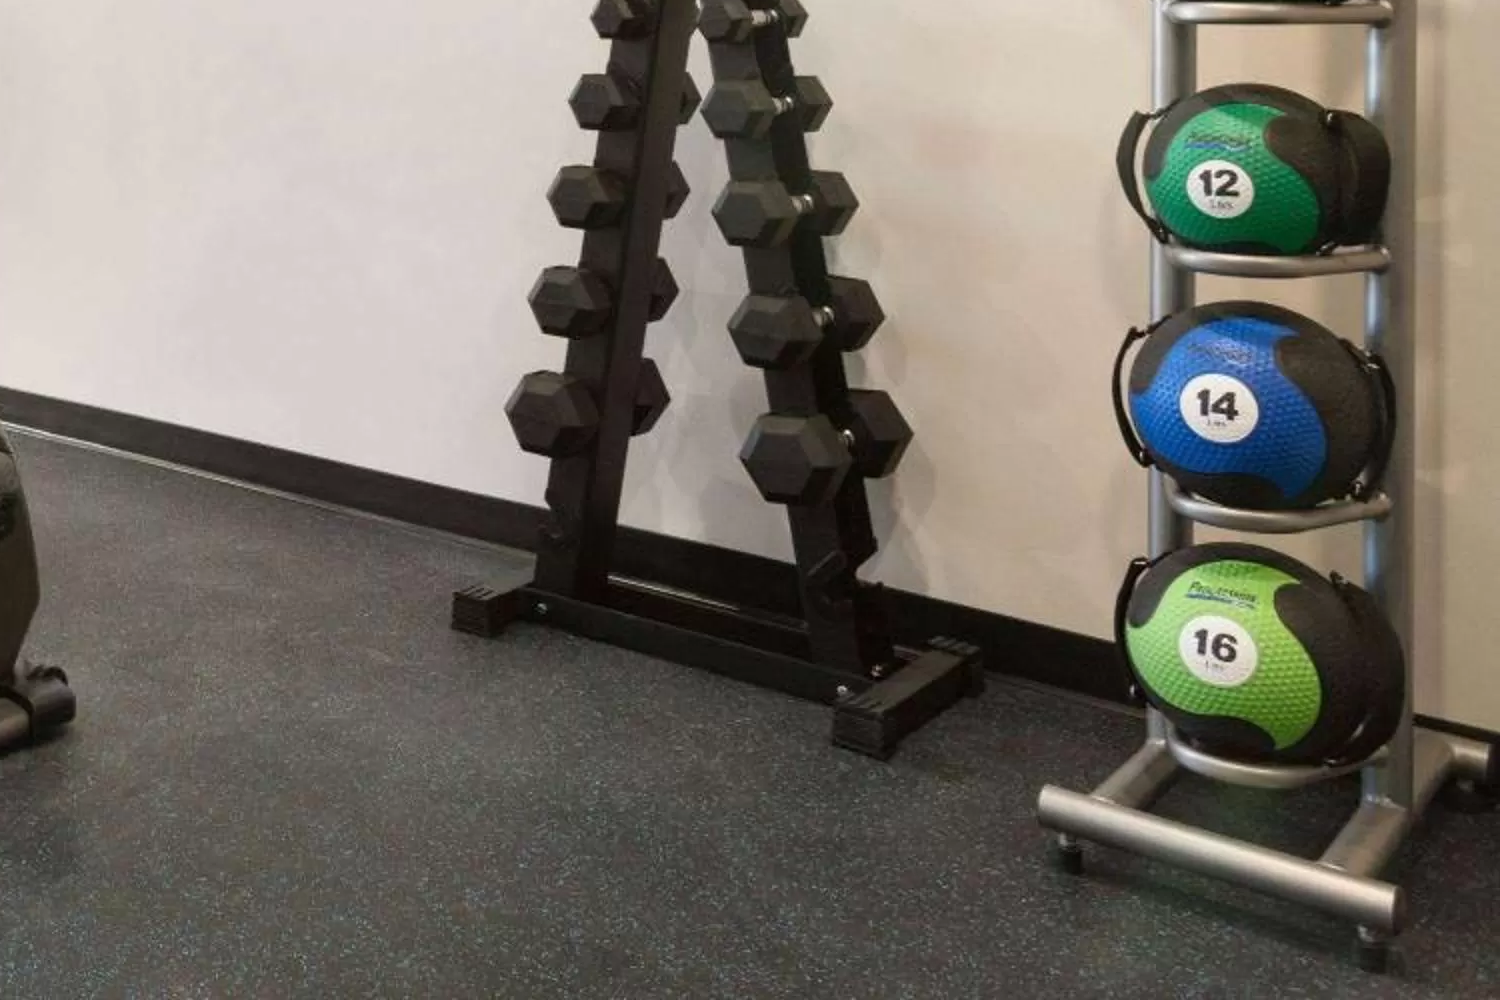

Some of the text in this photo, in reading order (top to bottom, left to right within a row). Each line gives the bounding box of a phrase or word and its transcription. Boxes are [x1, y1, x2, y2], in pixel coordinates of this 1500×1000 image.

[1199, 169, 1240, 197] 12
[1197, 388, 1239, 421] 14
[1194, 628, 1238, 664] 16
